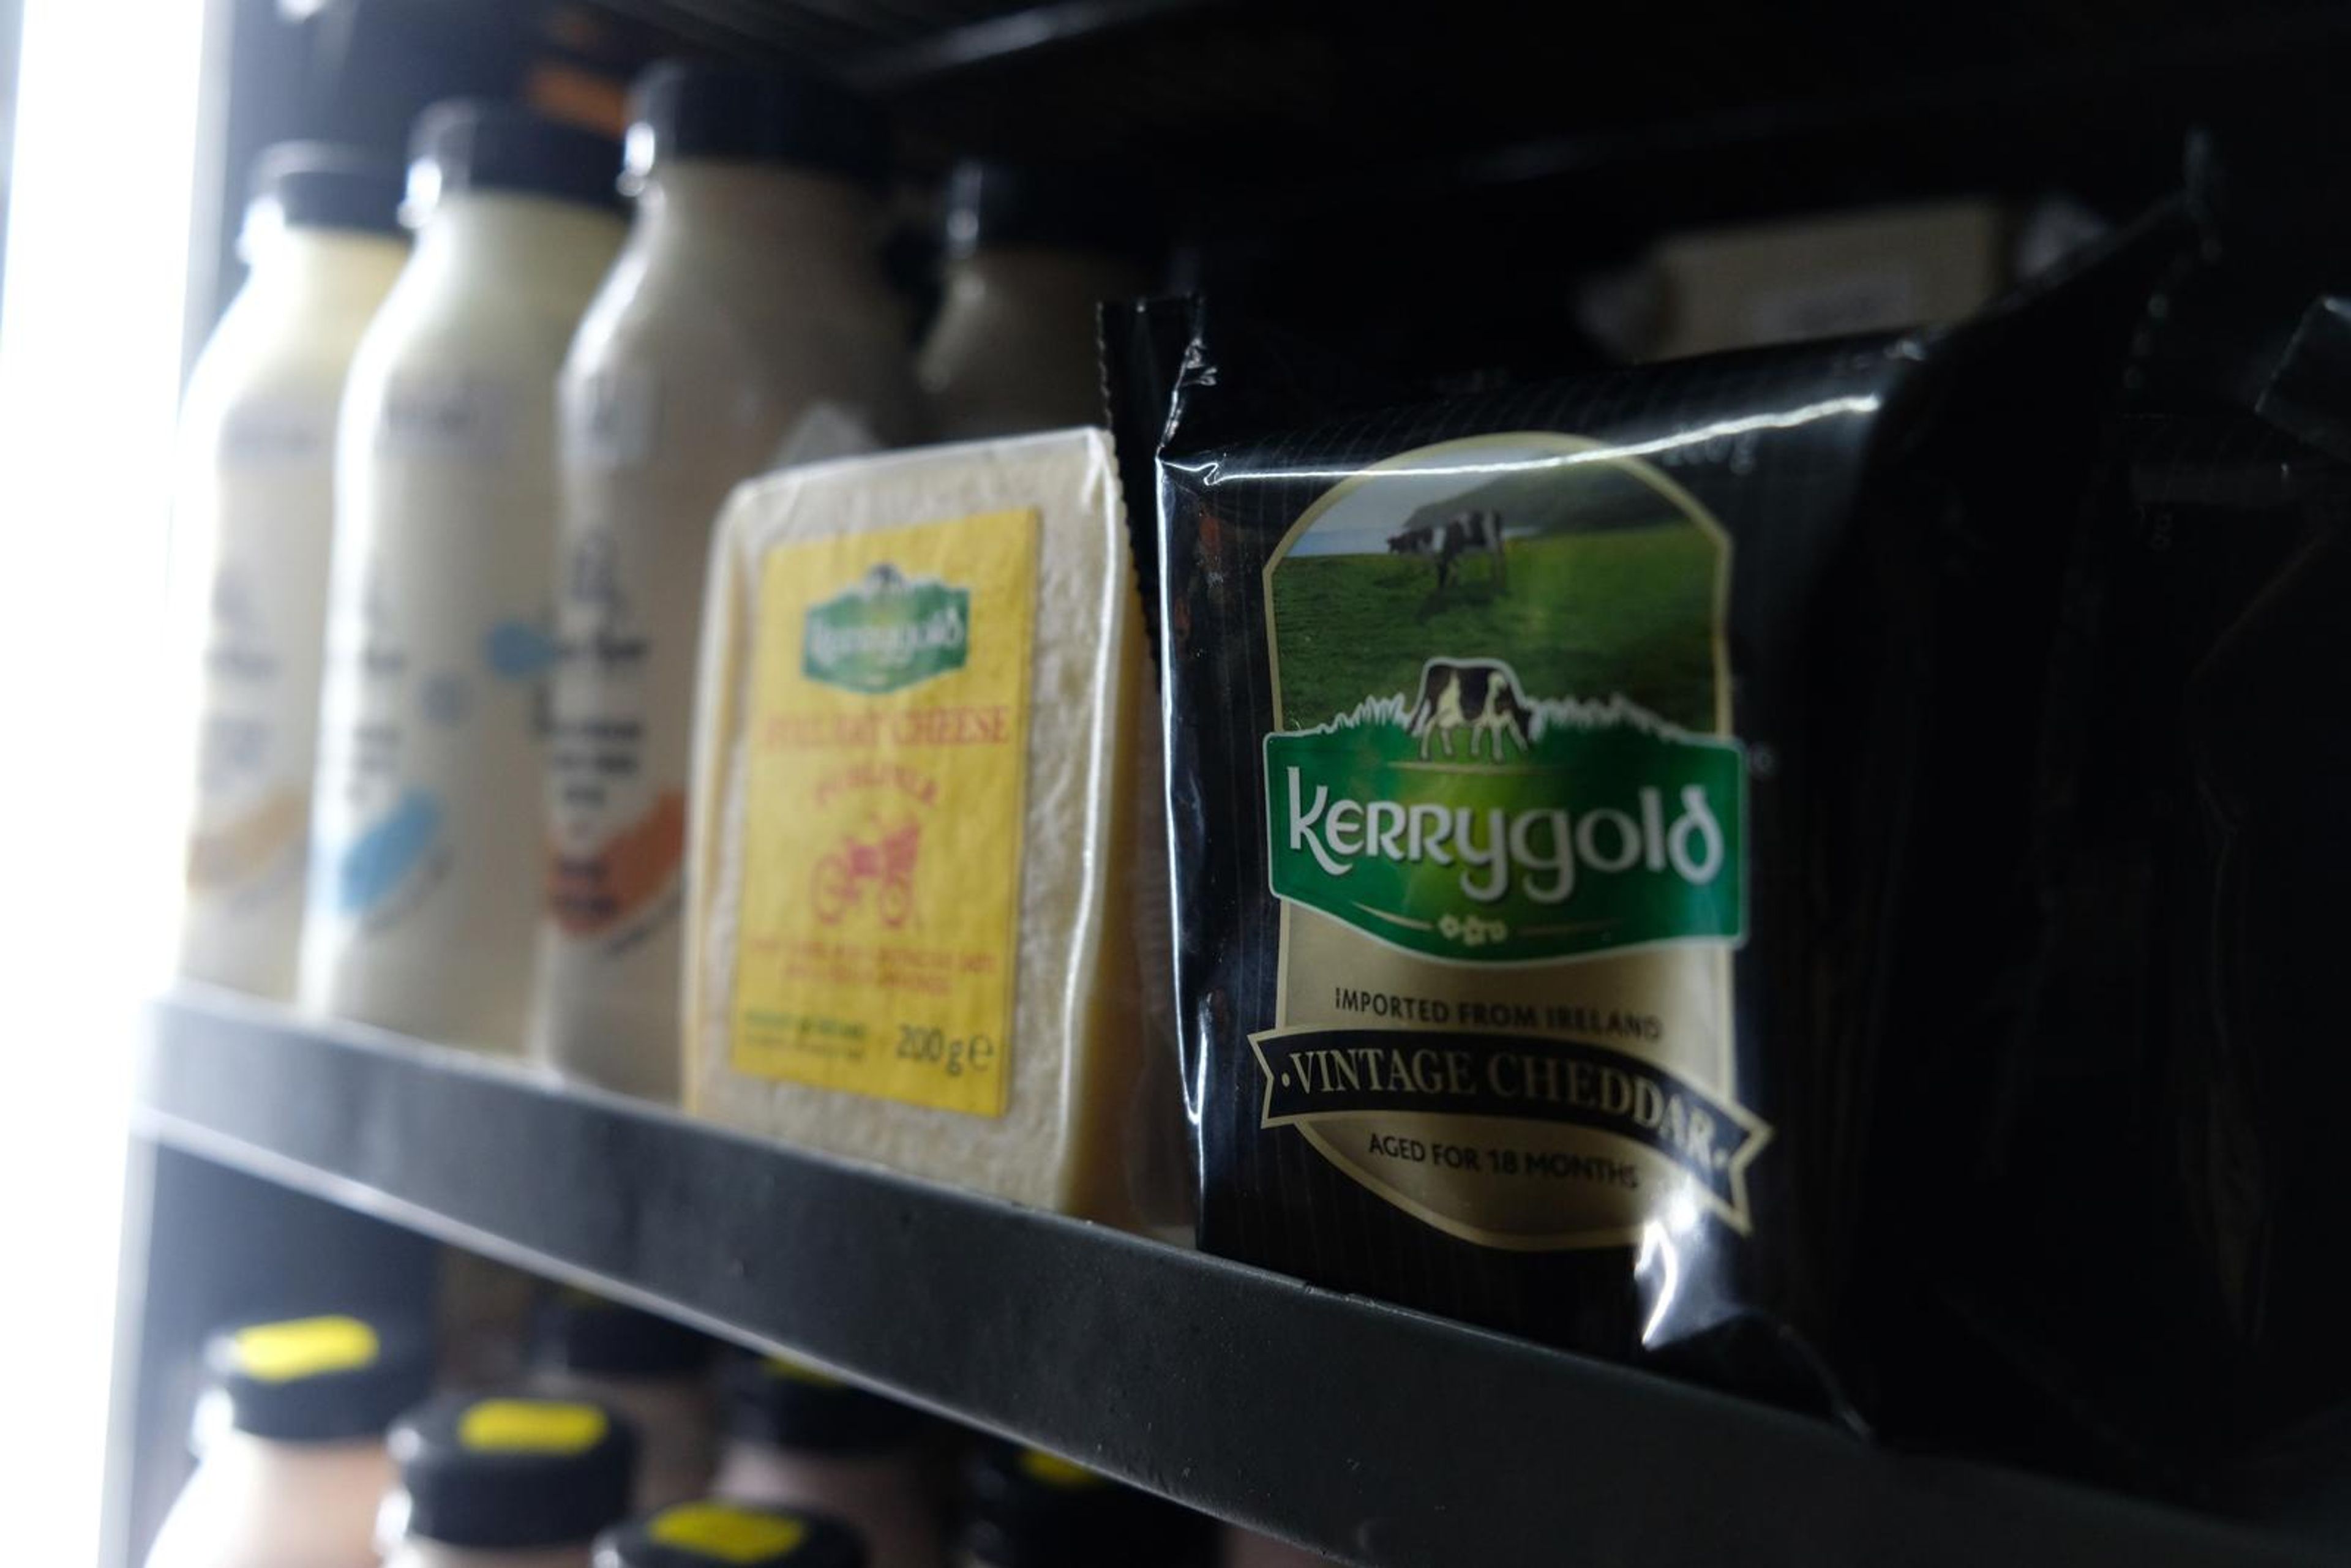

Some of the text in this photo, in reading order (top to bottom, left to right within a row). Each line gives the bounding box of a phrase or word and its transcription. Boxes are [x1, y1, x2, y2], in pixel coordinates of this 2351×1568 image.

[1335, 987, 1662, 1040] IMPORTED FROM IRELAND
[1289, 1048, 1715, 1168] VINTAGE CHEDDAR
[1369, 1133, 1639, 1189] AGED FOR 18 MONTHS
